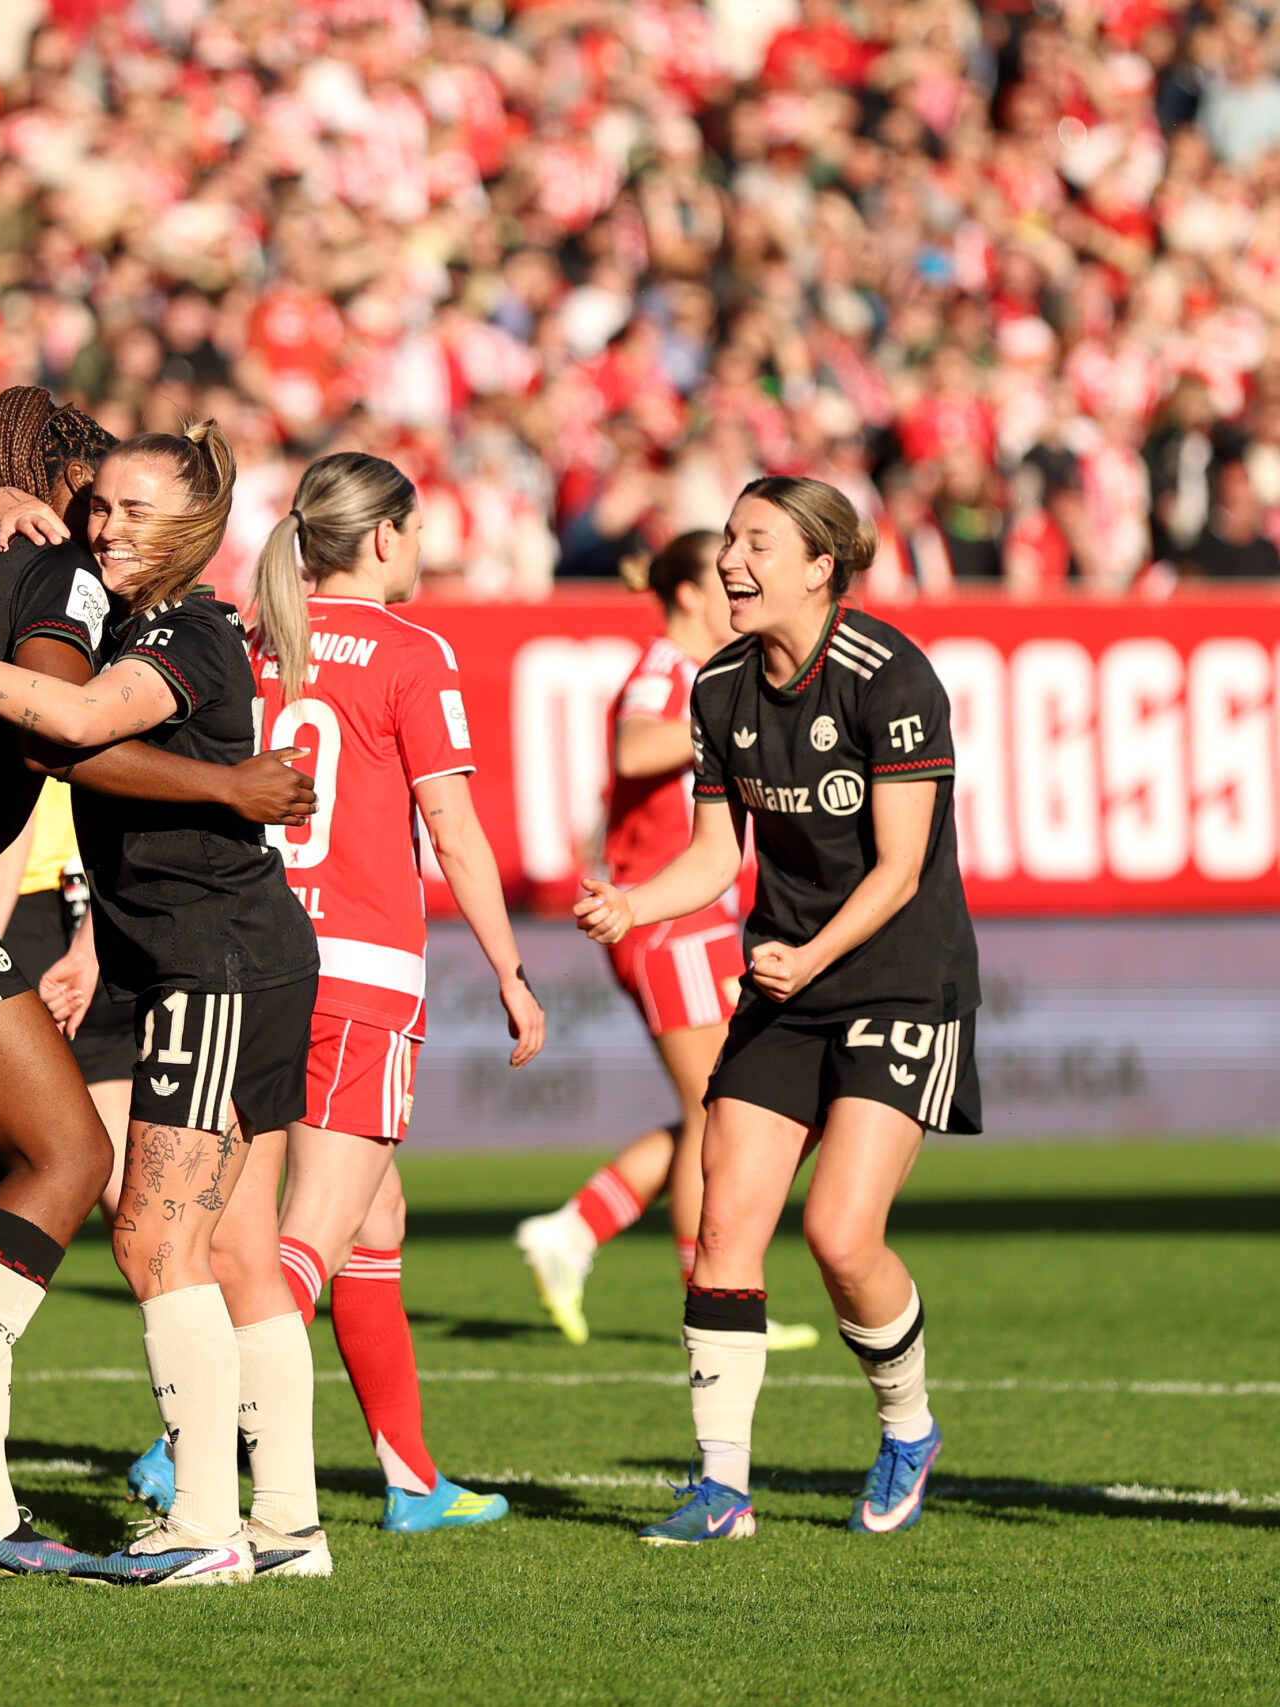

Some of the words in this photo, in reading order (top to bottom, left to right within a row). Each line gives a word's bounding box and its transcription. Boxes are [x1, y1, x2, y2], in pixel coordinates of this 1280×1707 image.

[310, 631, 378, 667] NION
[733, 775, 813, 814] Allianz
[162, 1198, 186, 1222] 31
